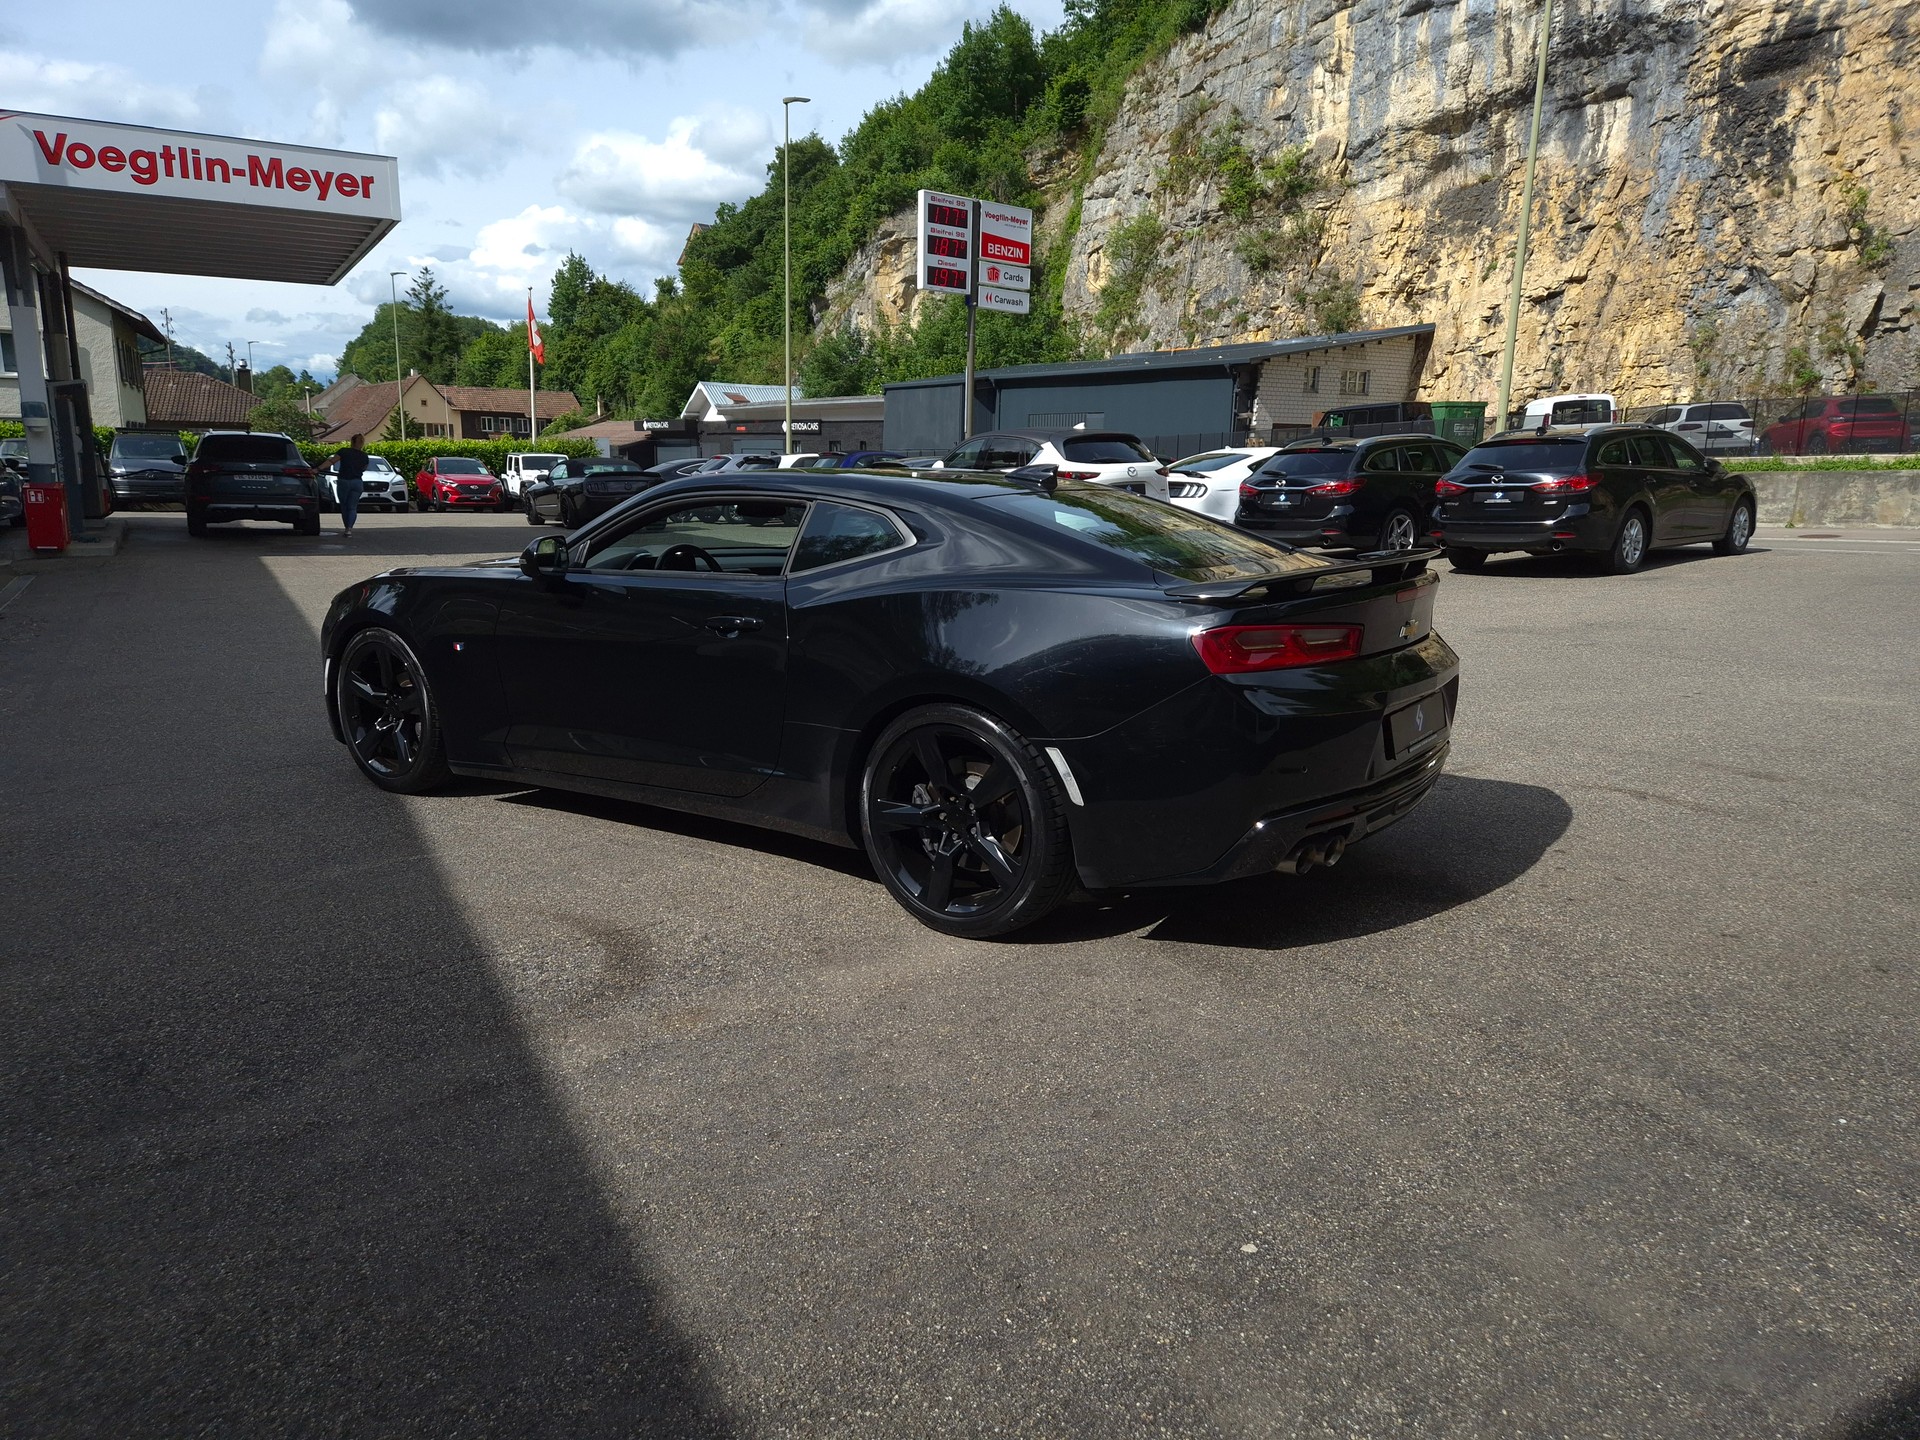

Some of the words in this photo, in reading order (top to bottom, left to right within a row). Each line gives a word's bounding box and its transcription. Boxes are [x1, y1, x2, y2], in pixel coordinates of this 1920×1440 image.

[32, 129, 375, 202] Voegtlin-Meyer
[930, 195, 954, 205] Bleifrei
[984, 210, 1029, 225] Voegtlin-Meyer
[930, 227, 954, 236] Bleifrei
[987, 242, 1024, 259] BENZIN
[937, 259, 958, 267] Diesel
[1003, 271, 1024, 283] Cards
[994, 294, 1024, 307] Carwash
